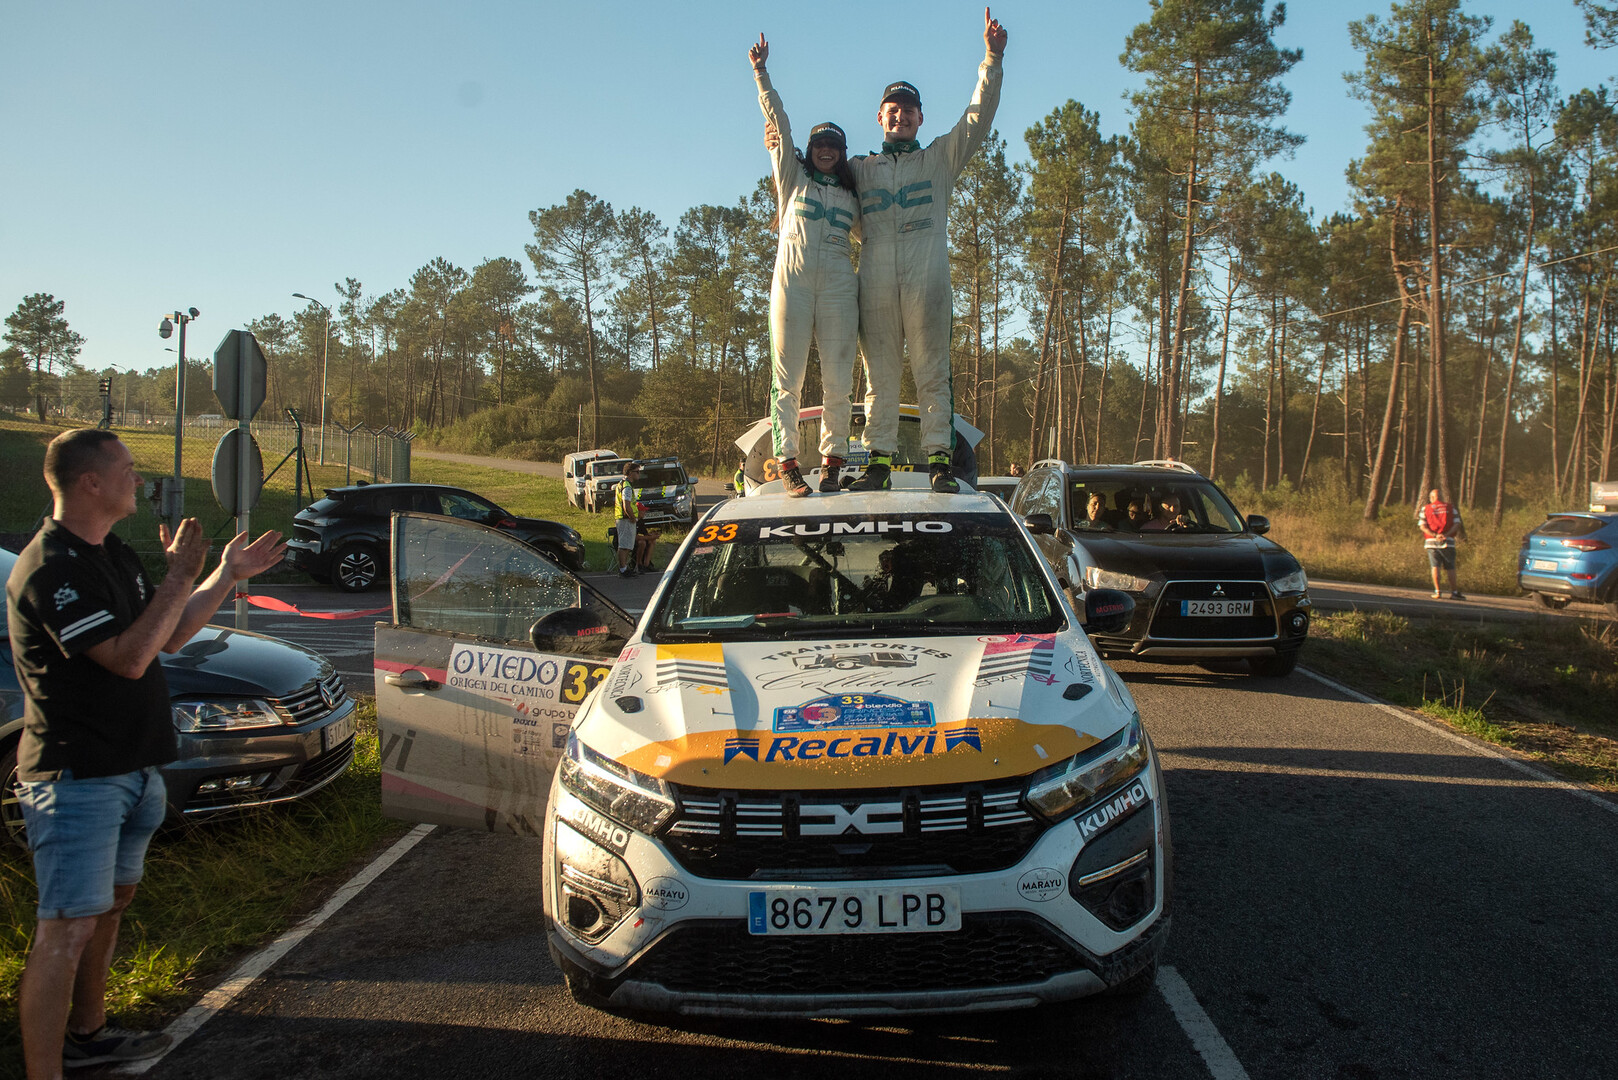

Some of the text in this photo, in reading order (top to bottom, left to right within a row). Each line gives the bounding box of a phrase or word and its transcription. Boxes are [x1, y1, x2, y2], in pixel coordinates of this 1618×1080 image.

[698, 523, 739, 543] 33
[759, 520, 953, 538] KUMHO
[1095, 603, 1125, 614] MOTRIO
[1191, 602, 1251, 615] 2493 GRM
[577, 625, 608, 637] MOTRIO
[761, 642, 952, 662] TRANSPORTES
[453, 649, 559, 686] OVIEDO
[450, 676, 555, 700] ORIGEN DEL CAMINO
[841, 695, 865, 704] 33
[532, 707, 566, 719] grupo
[765, 731, 938, 763] Recalvi
[1079, 783, 1146, 837] KUMHO
[1022, 879, 1062, 890] MARAYU
[646, 888, 685, 900] MARAYU
[771, 894, 863, 929] 8679
[878, 893, 946, 927] LPB
